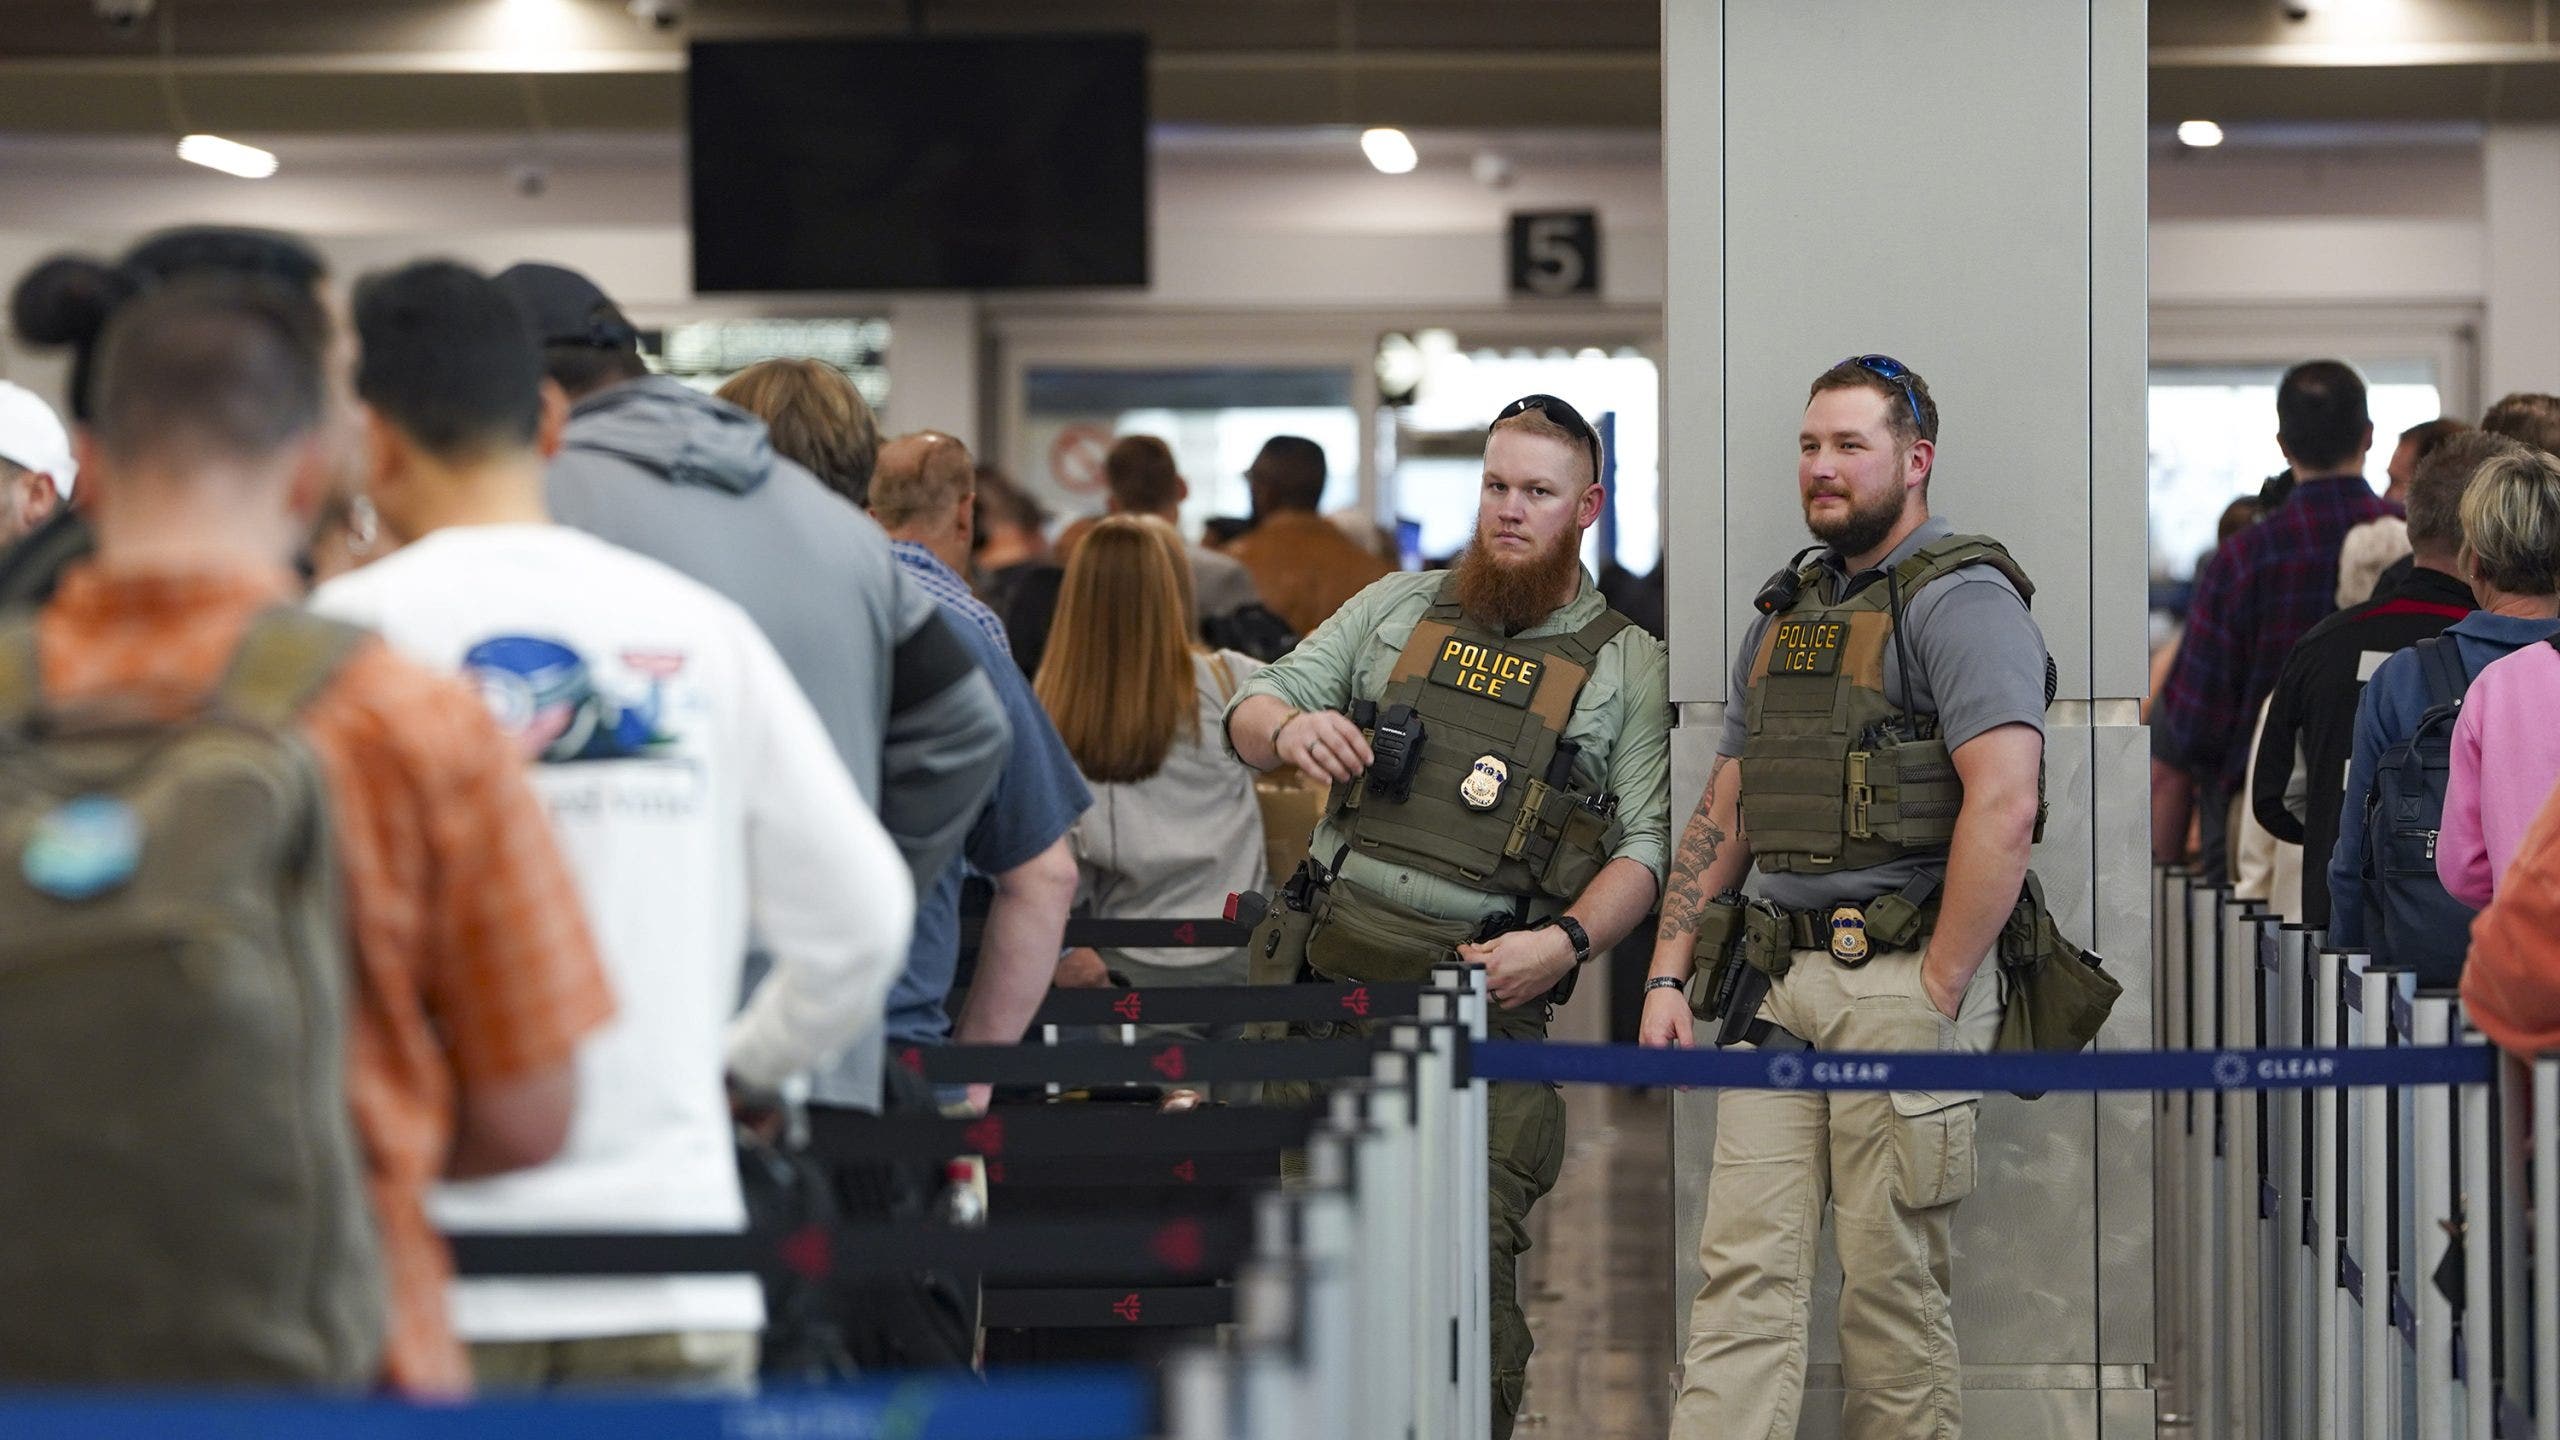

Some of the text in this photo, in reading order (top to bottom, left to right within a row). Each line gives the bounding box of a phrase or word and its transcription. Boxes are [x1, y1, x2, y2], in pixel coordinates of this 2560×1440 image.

[1524, 220, 1586, 296] 5
[1778, 624, 1839, 649] POLICE
[1442, 640, 1538, 685] POLICE
[1785, 651, 1817, 671] ICE
[1455, 669, 1506, 698] ICE
[1812, 1061, 1889, 1083] CLEAR
[2258, 1058, 2334, 1080] CLEAR
